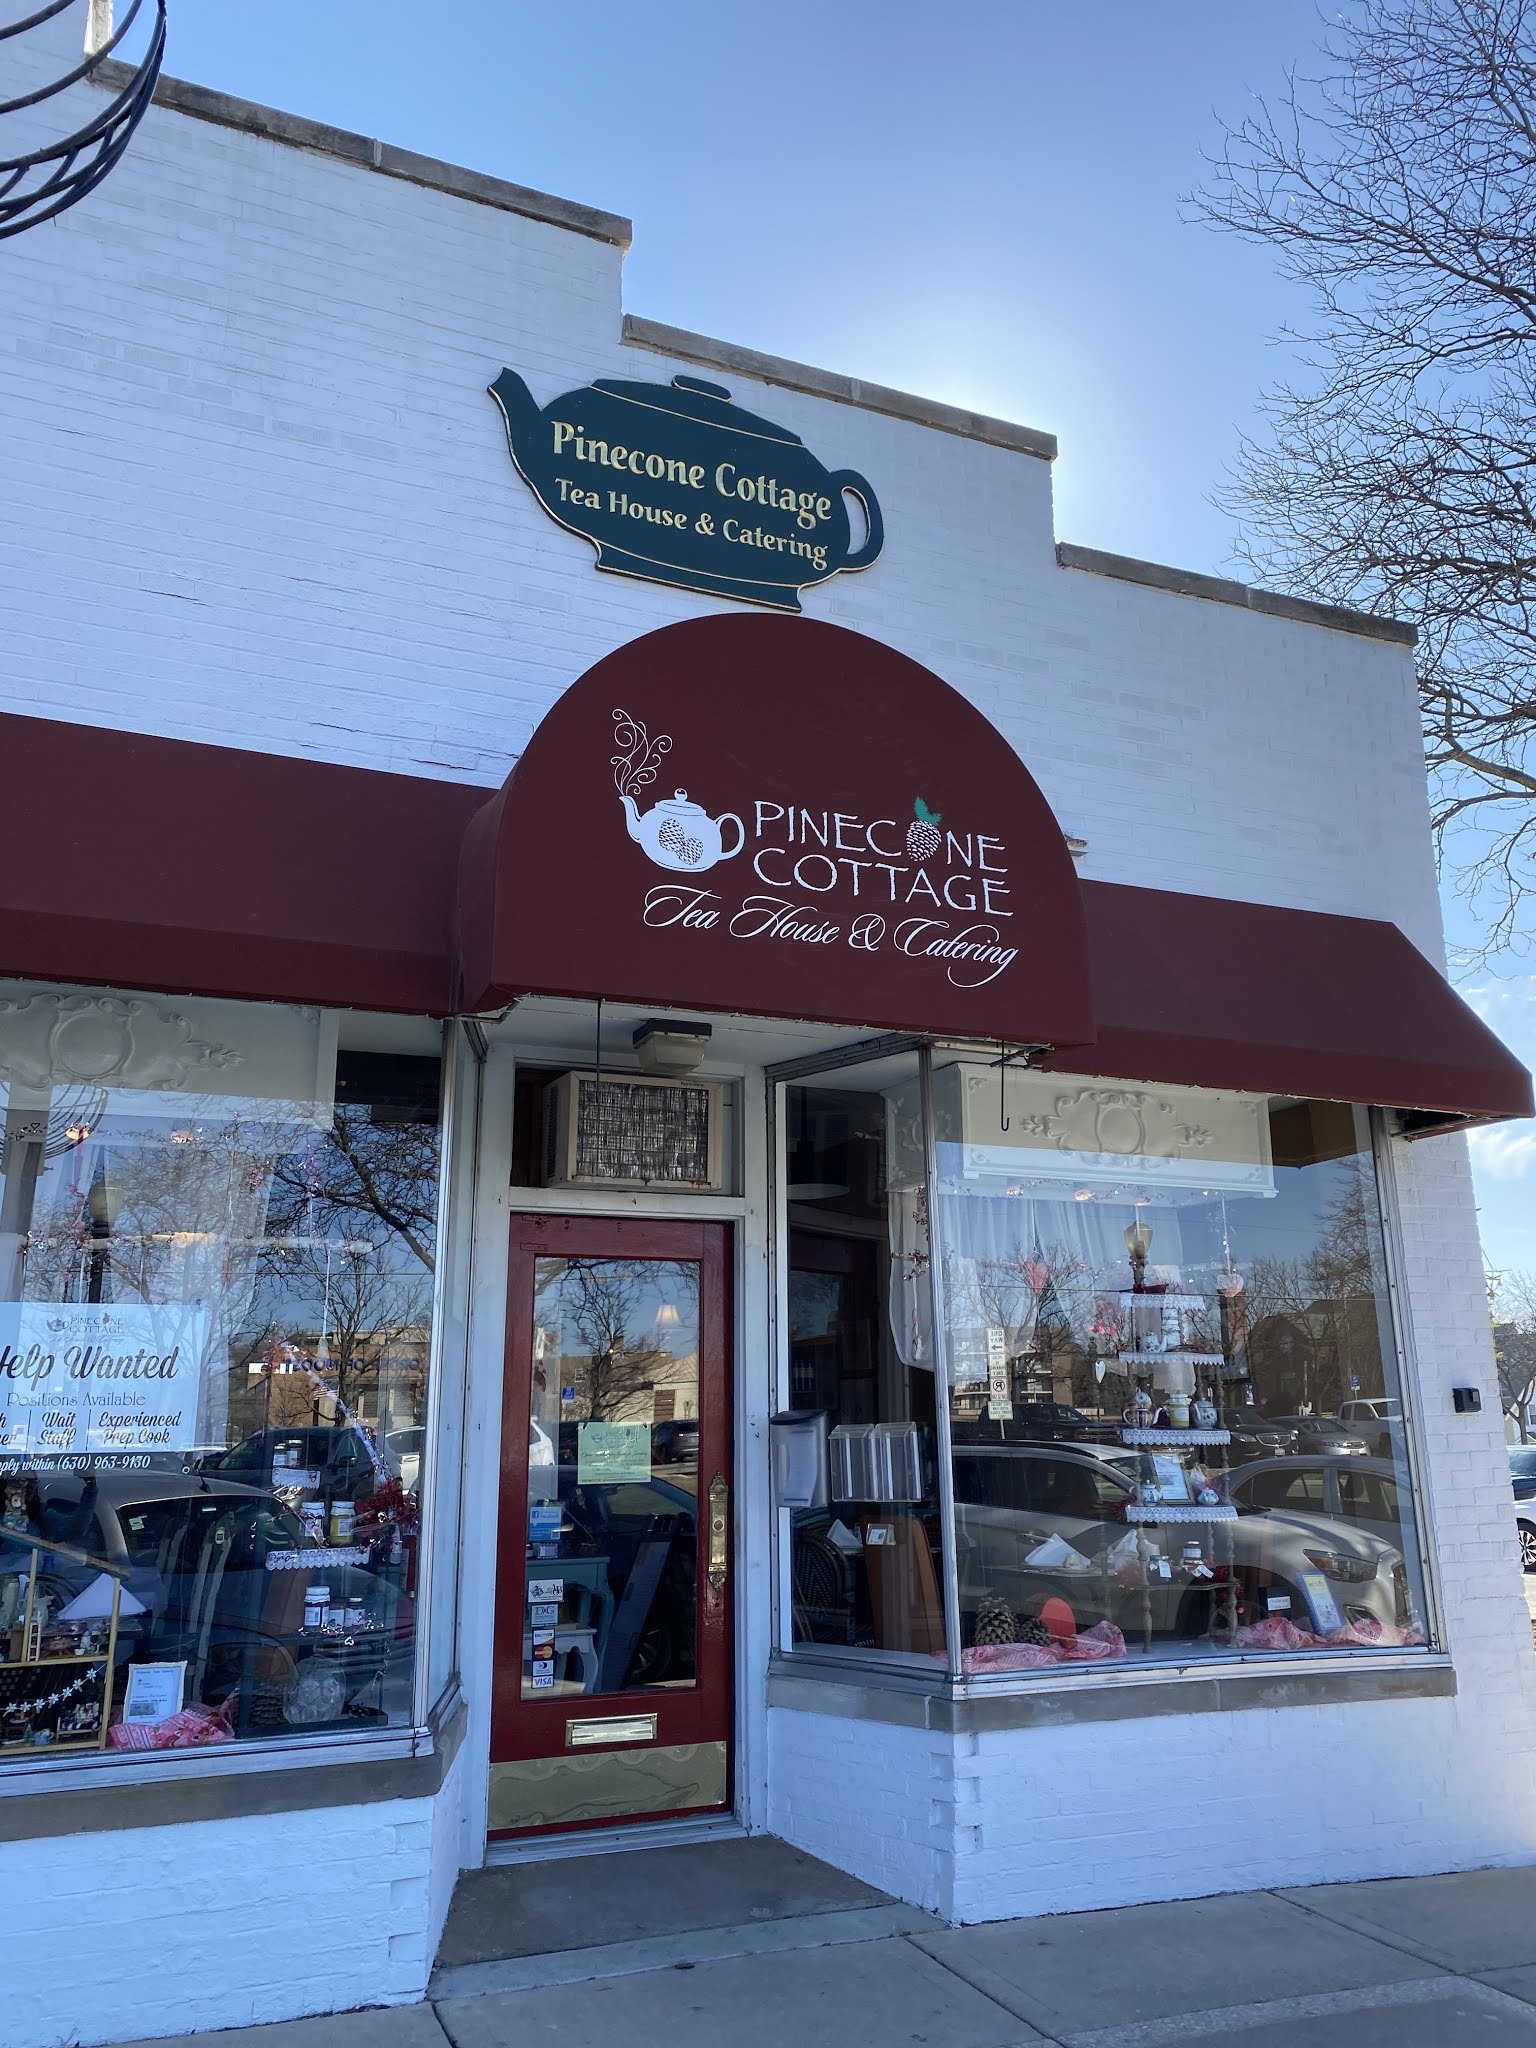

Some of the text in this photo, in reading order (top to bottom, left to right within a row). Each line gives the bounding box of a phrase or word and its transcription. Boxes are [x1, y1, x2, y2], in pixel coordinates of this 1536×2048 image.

[551, 420, 832, 530] Pinecone Cottage
[555, 477, 828, 571] Tea House & Catering
[752, 847, 1014, 916] COTTAGE
[643, 884, 1020, 988] Tea House & Catering
[69, 1325, 124, 1334] COTTAGE
[63, 1345, 179, 1379] Wanted
[6, 1391, 146, 1407] Positions Available
[41, 1411, 76, 1428] Wait
[98, 1410, 182, 1431] Experienced
[37, 1428, 77, 1450] Staff
[103, 1427, 171, 1449] Prep Cook
[22, 1458, 55, 1471] within
[57, 1454, 92, 1472] (630)
[94, 1455, 151, 1470] 963-9130
[534, 1677, 552, 1686] VISA
